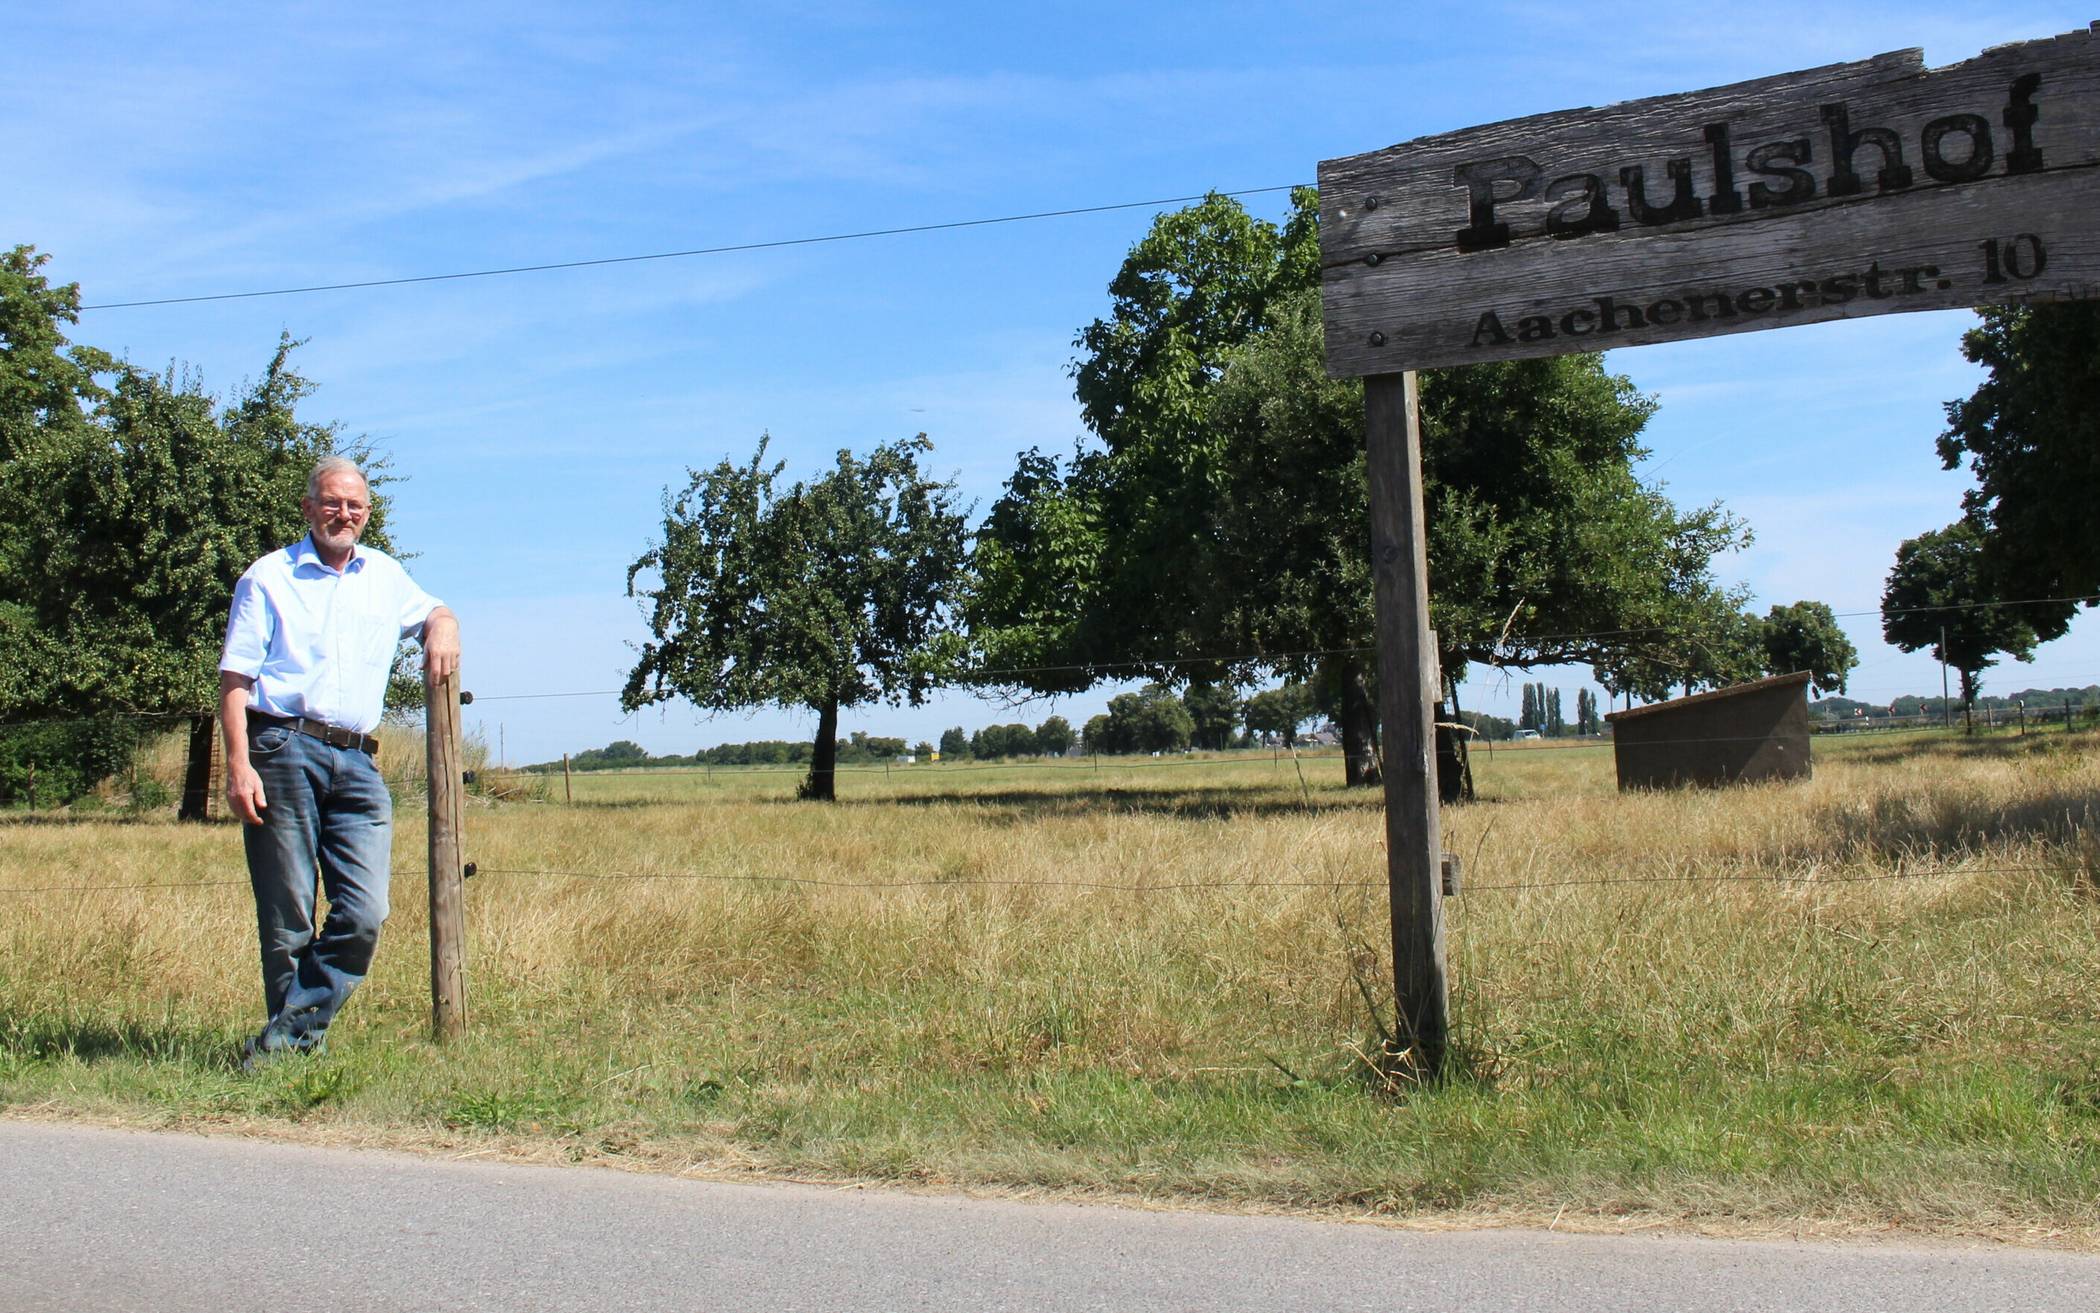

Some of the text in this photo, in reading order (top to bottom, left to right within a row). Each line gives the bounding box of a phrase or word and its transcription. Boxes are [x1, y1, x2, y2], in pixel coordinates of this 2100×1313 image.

[1455, 73, 2042, 252] Paulshof
[1471, 233, 2046, 346] Aachenerstr. 10
